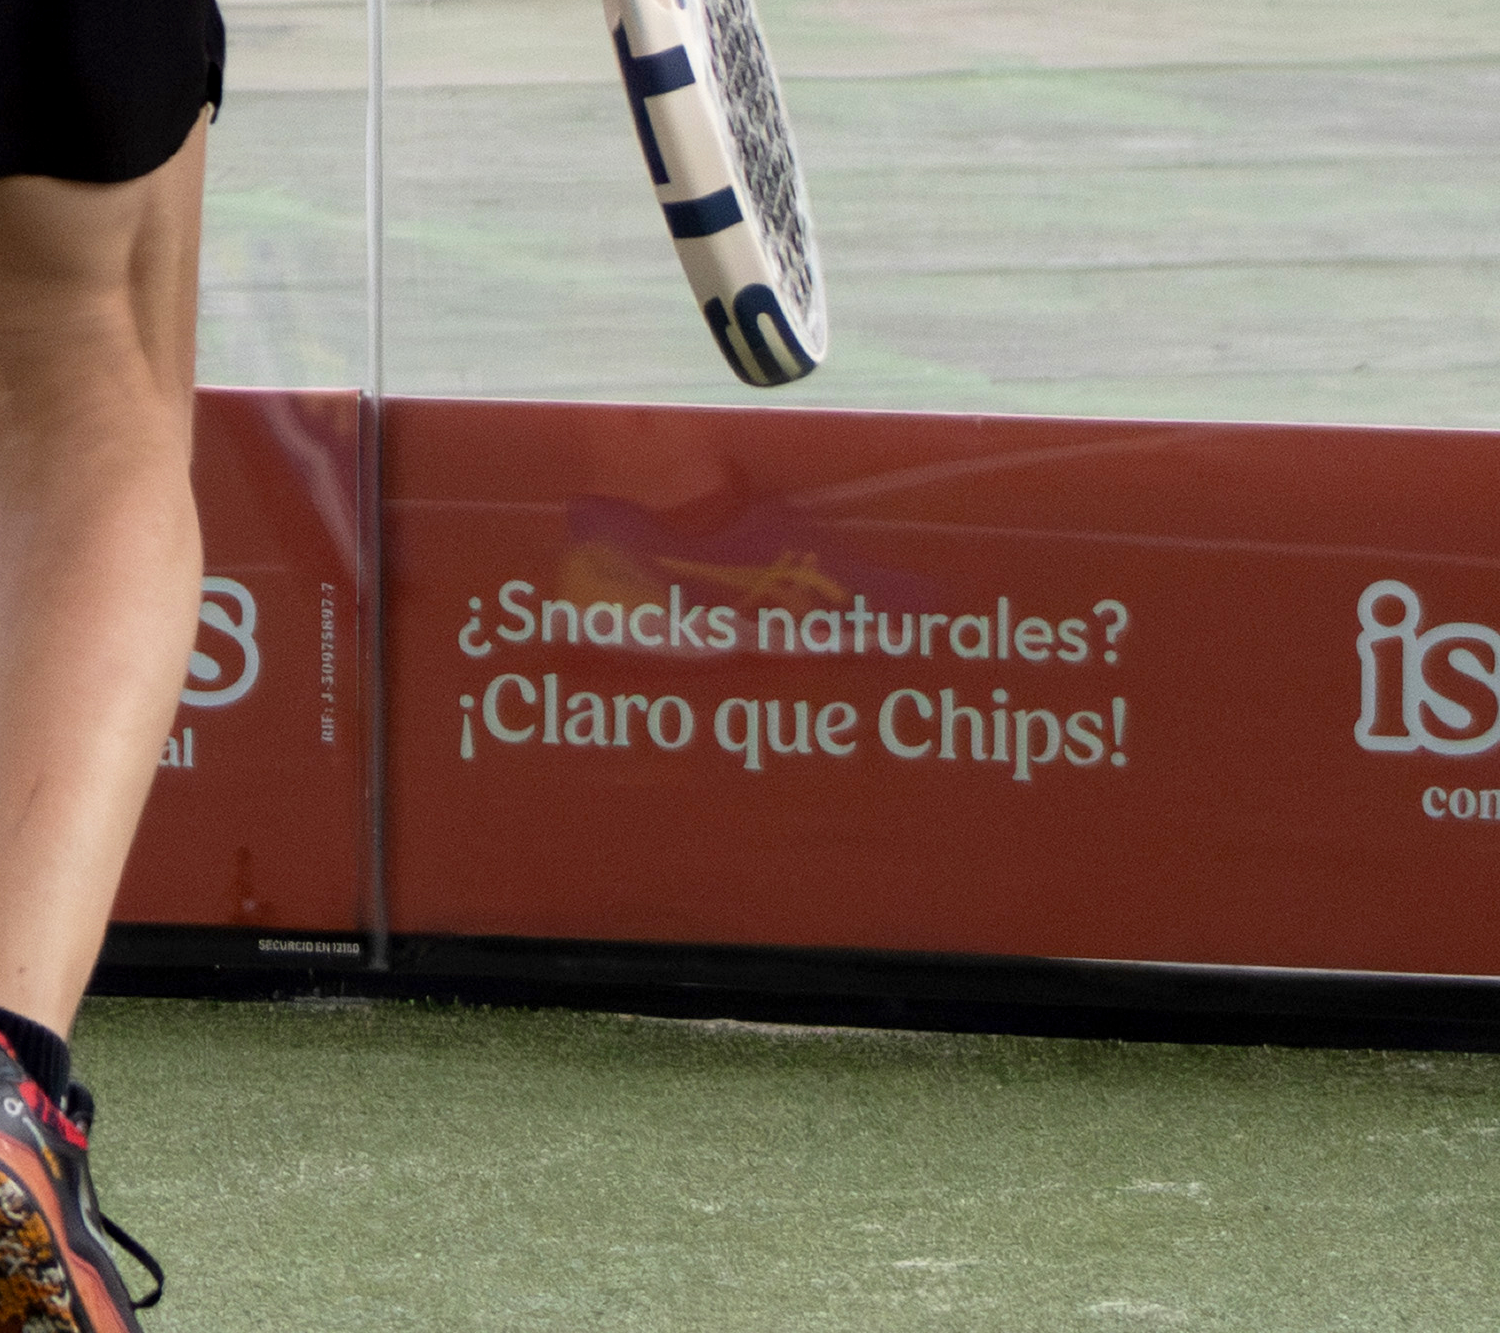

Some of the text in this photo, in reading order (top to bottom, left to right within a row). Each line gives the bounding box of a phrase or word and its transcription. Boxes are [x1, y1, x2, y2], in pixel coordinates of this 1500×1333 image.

[457, 582, 1128, 663] ¿Snacks naturales?
[460, 673, 1126, 781] ¡Claro que Chips!
